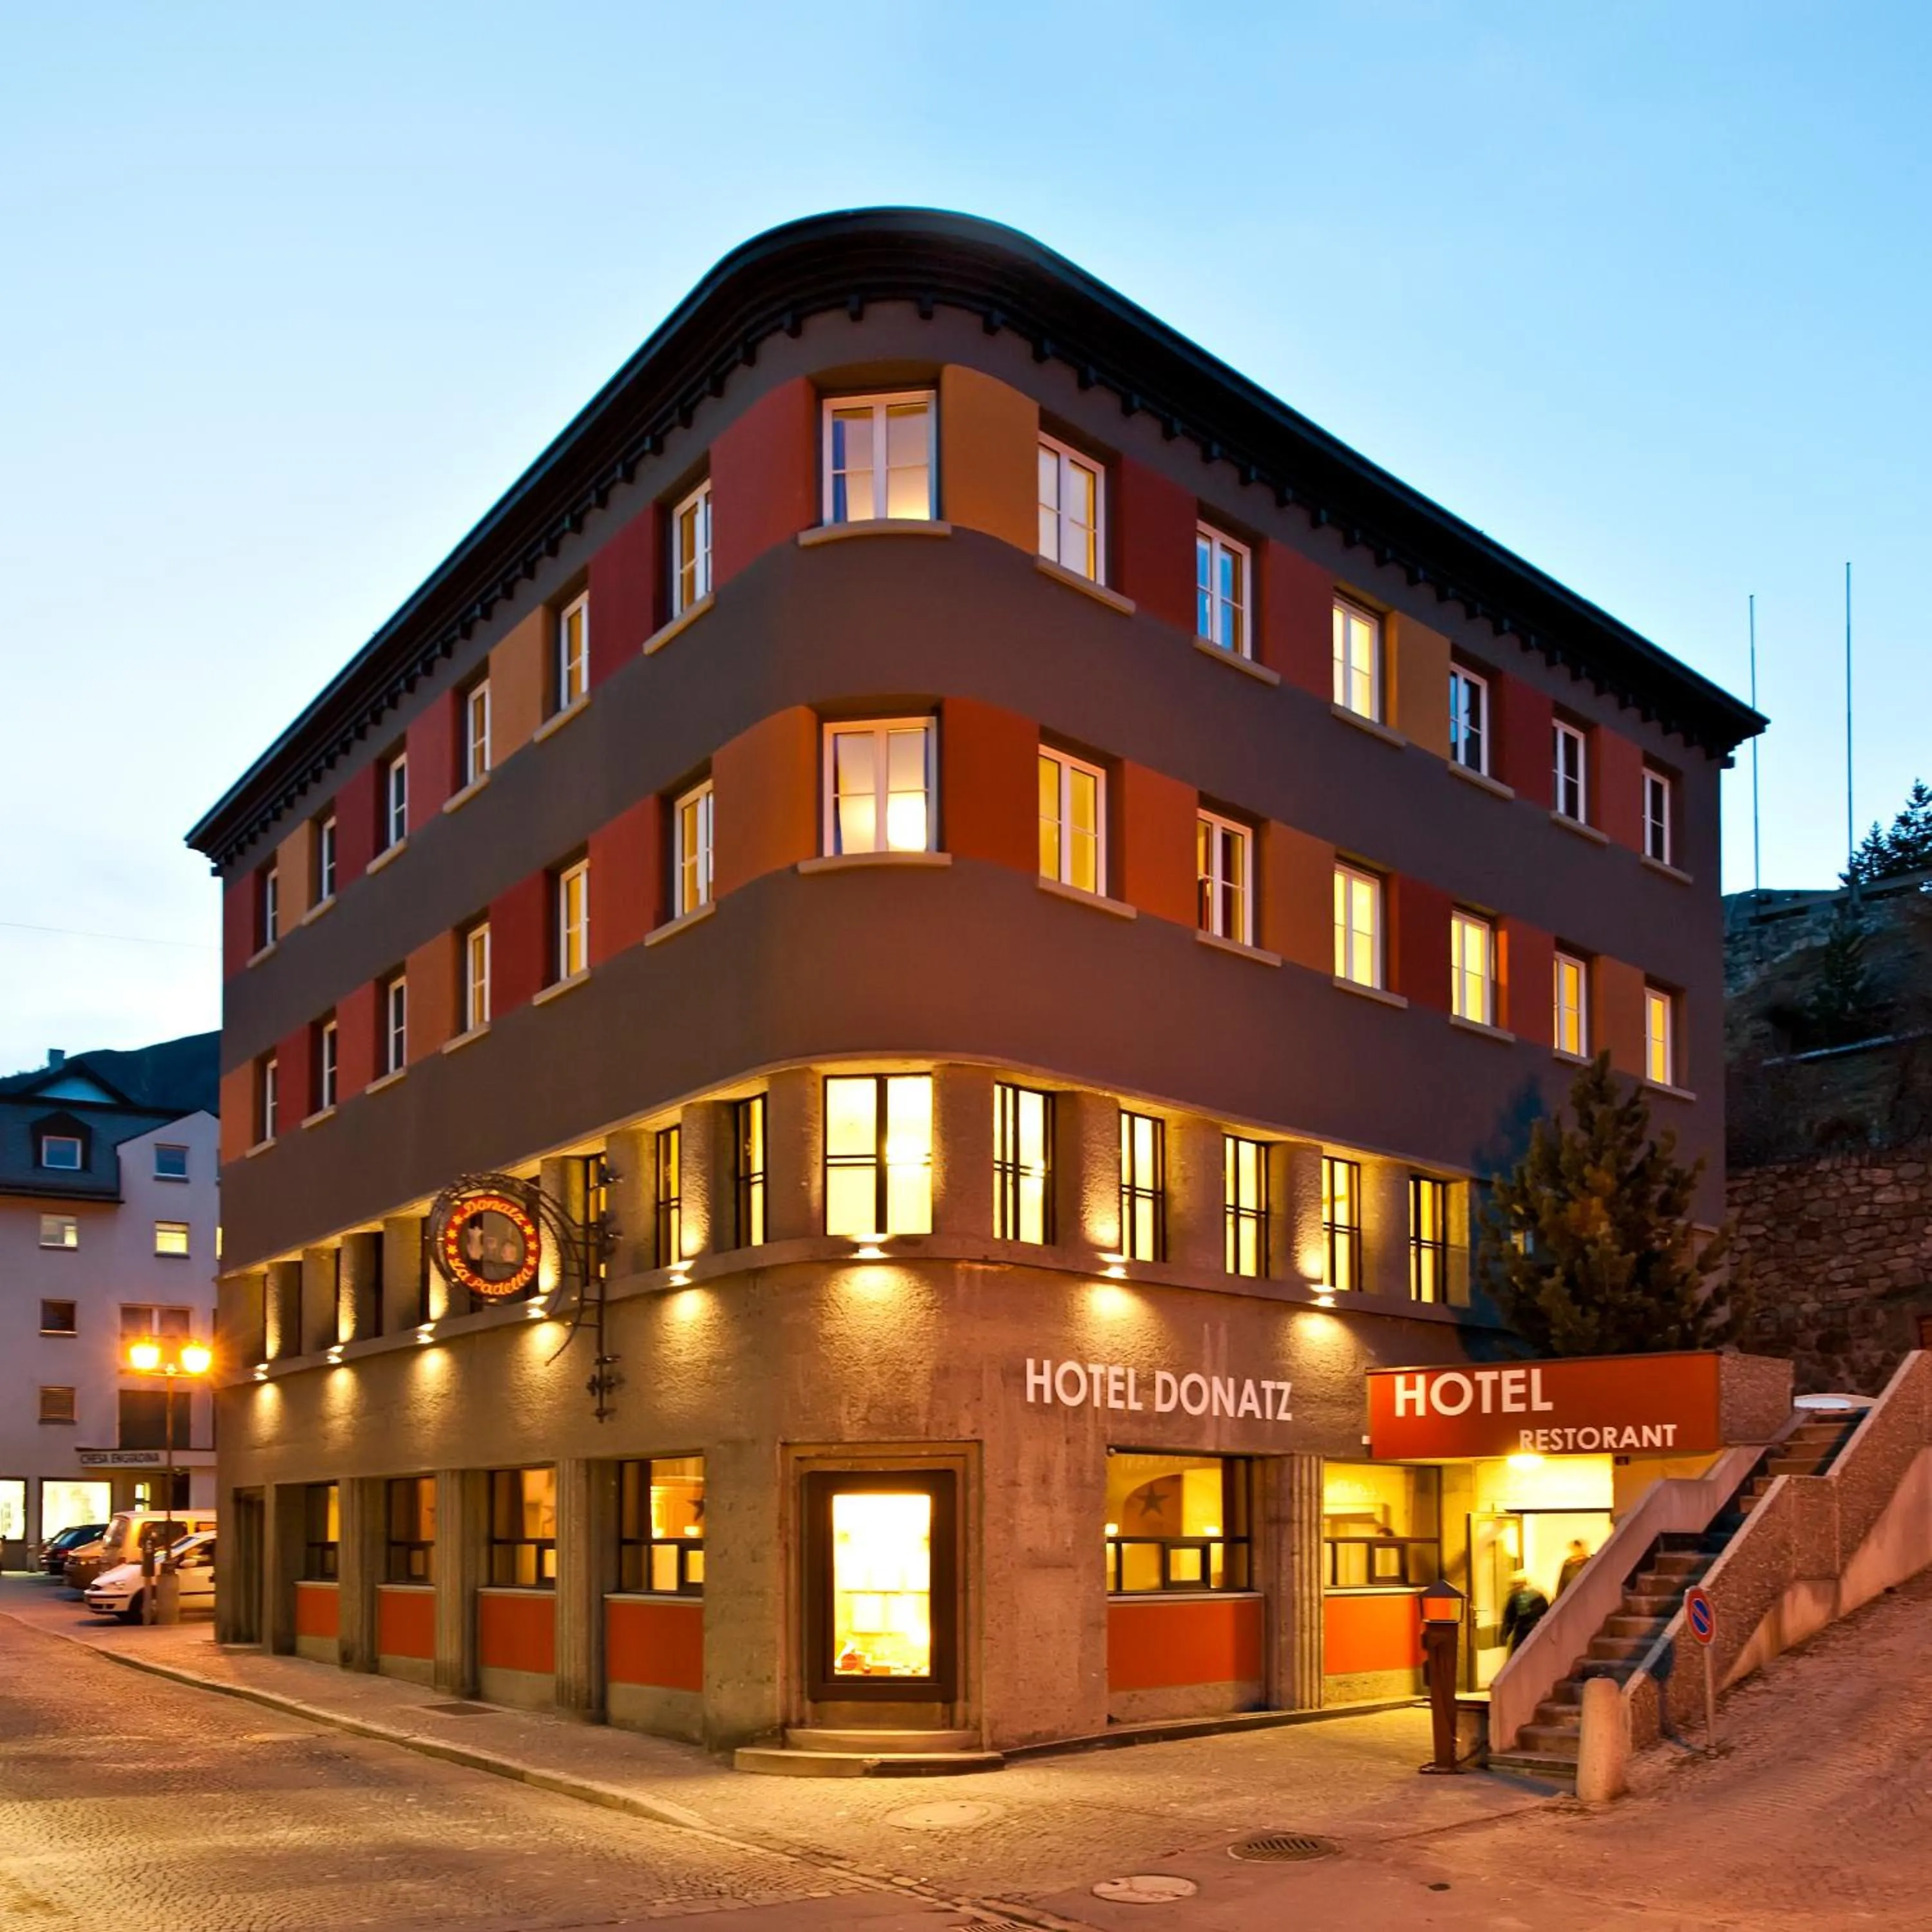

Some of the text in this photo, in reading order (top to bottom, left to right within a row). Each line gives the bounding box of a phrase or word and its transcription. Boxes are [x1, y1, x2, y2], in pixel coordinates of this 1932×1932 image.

[463, 1200, 526, 1226] Donatz
[468, 1267, 535, 1294] Padella
[1026, 1358, 1293, 1421] HOTEL DONATZ
[1394, 1368, 1553, 1417] HOTEL
[1519, 1424, 1678, 1452] RESTORANT
